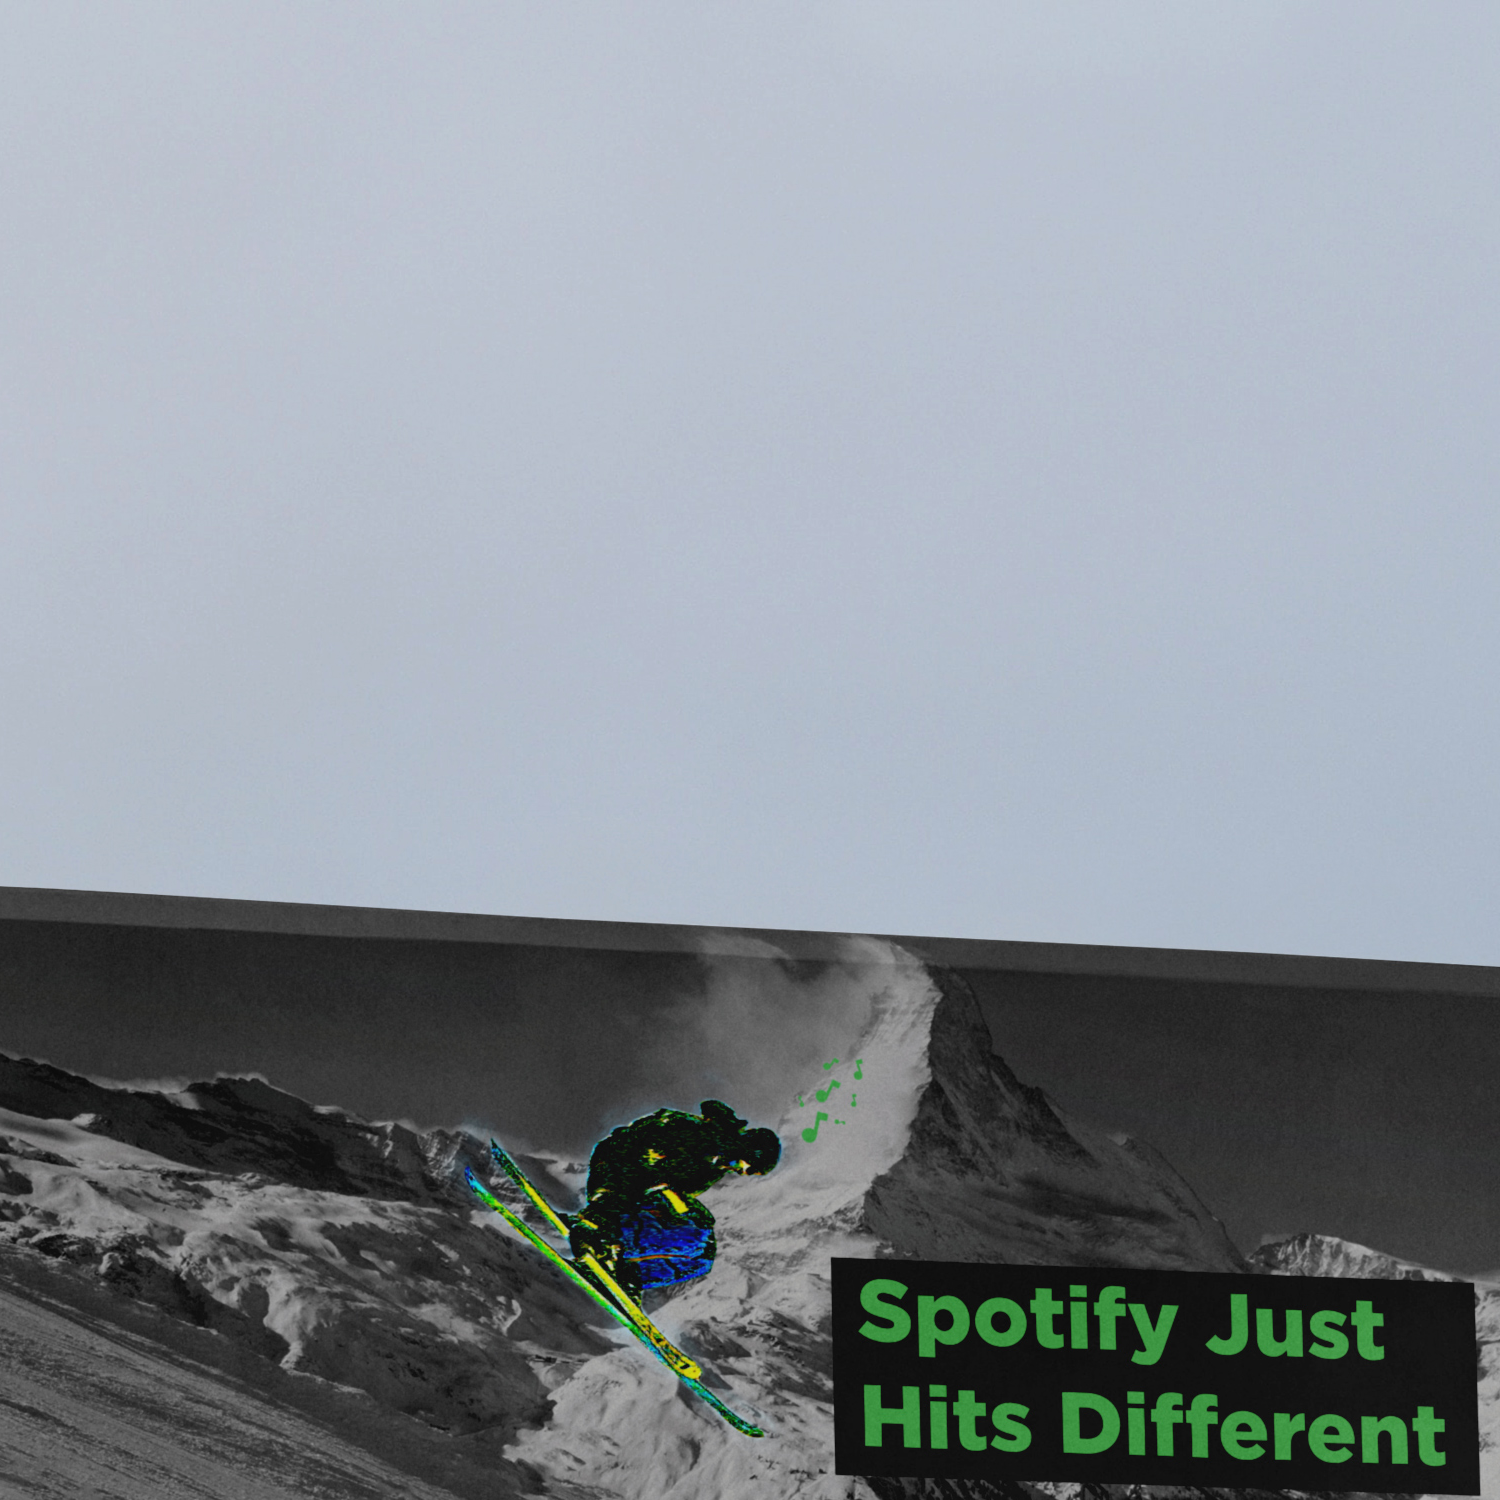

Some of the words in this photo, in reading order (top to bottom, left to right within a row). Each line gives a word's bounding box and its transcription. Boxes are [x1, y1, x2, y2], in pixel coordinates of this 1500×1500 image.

[858, 1279, 1179, 1365] Spotify
[1205, 1293, 1385, 1361] Just
[863, 1384, 1032, 1452] Hits
[1062, 1391, 1446, 1467] Different
